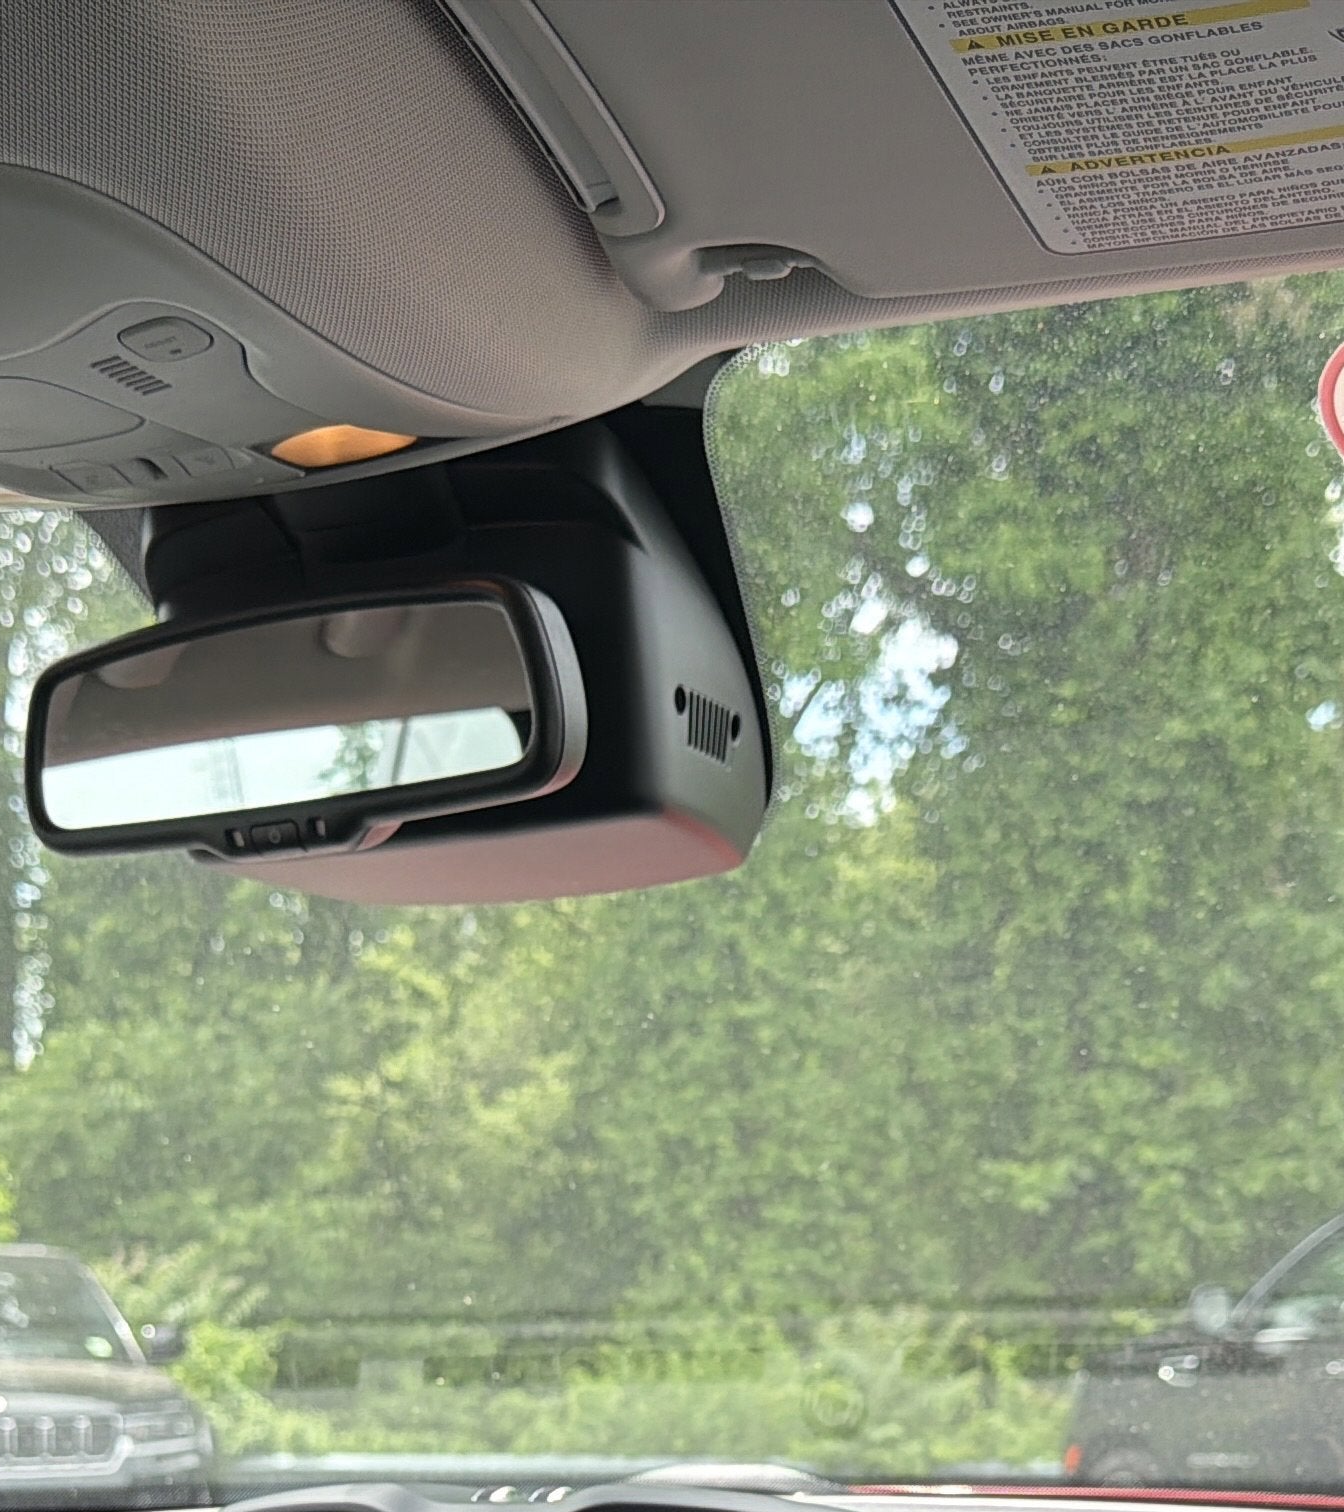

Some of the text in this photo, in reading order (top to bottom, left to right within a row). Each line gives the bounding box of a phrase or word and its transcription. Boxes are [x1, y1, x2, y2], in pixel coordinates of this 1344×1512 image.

[946, 1, 1033, 18] RESTRAINTS.
[952, 17, 976, 27] SEE
[980, 9, 1042, 24] OWNER'S
[1045, 2, 1102, 16] MANUAL
[958, 24, 1000, 37] ABOUT
[960, 20, 1264, 66] MÊME AVEC DES SACS GONFLABLES
[996, 13, 1188, 48] MISE EN GARDE
[986, 76, 1010, 85] LES
[1014, 68, 1074, 82] ENFANTS
[1078, 61, 1136, 75] PEUVENT
[1220, 48, 1240, 58] OU
[991, 77, 1068, 93] GRAVEMENT
[1137, 66, 1168, 77] PAR
[1172, 64, 1192, 73] UN
[1196, 60, 1220, 70] SAC
[995, 92, 1012, 101] LA
[1016, 83, 1093, 99] BANQUETTE
[1160, 73, 1183, 83] EST
[1187, 70, 1206, 80] LA
[1209, 64, 1255, 77] PLACE
[1258, 61, 1276, 70] LA
[1280, 54, 1317, 66] PLUS
[1026, 103, 1074, 116] JAMAIS
[1076, 96, 1128, 110] PLACER
[1131, 94, 1150, 104] UN
[1197, 84, 1234, 96] POUR
[1238, 75, 1292, 90] ENFANT
[1068, 108, 1102, 119] VERS
[1210, 90, 1254, 103] AVANT
[1258, 86, 1278, 96] DU
[1090, 88, 1125, 100] POUR
[1129, 86, 1156, 95] LES
[1070, 142, 1230, 172] ADVERTENCIA
[1070, 172, 1103, 184] CON
[1107, 165, 1170, 180] BOLSAS
[1176, 163, 1195, 172] DE
[1202, 157, 1237, 169] AIRE
[1050, 184, 1074, 194] LOS
[1217, 180, 1234, 188] EL
[1236, 173, 1281, 185] LUGAR
